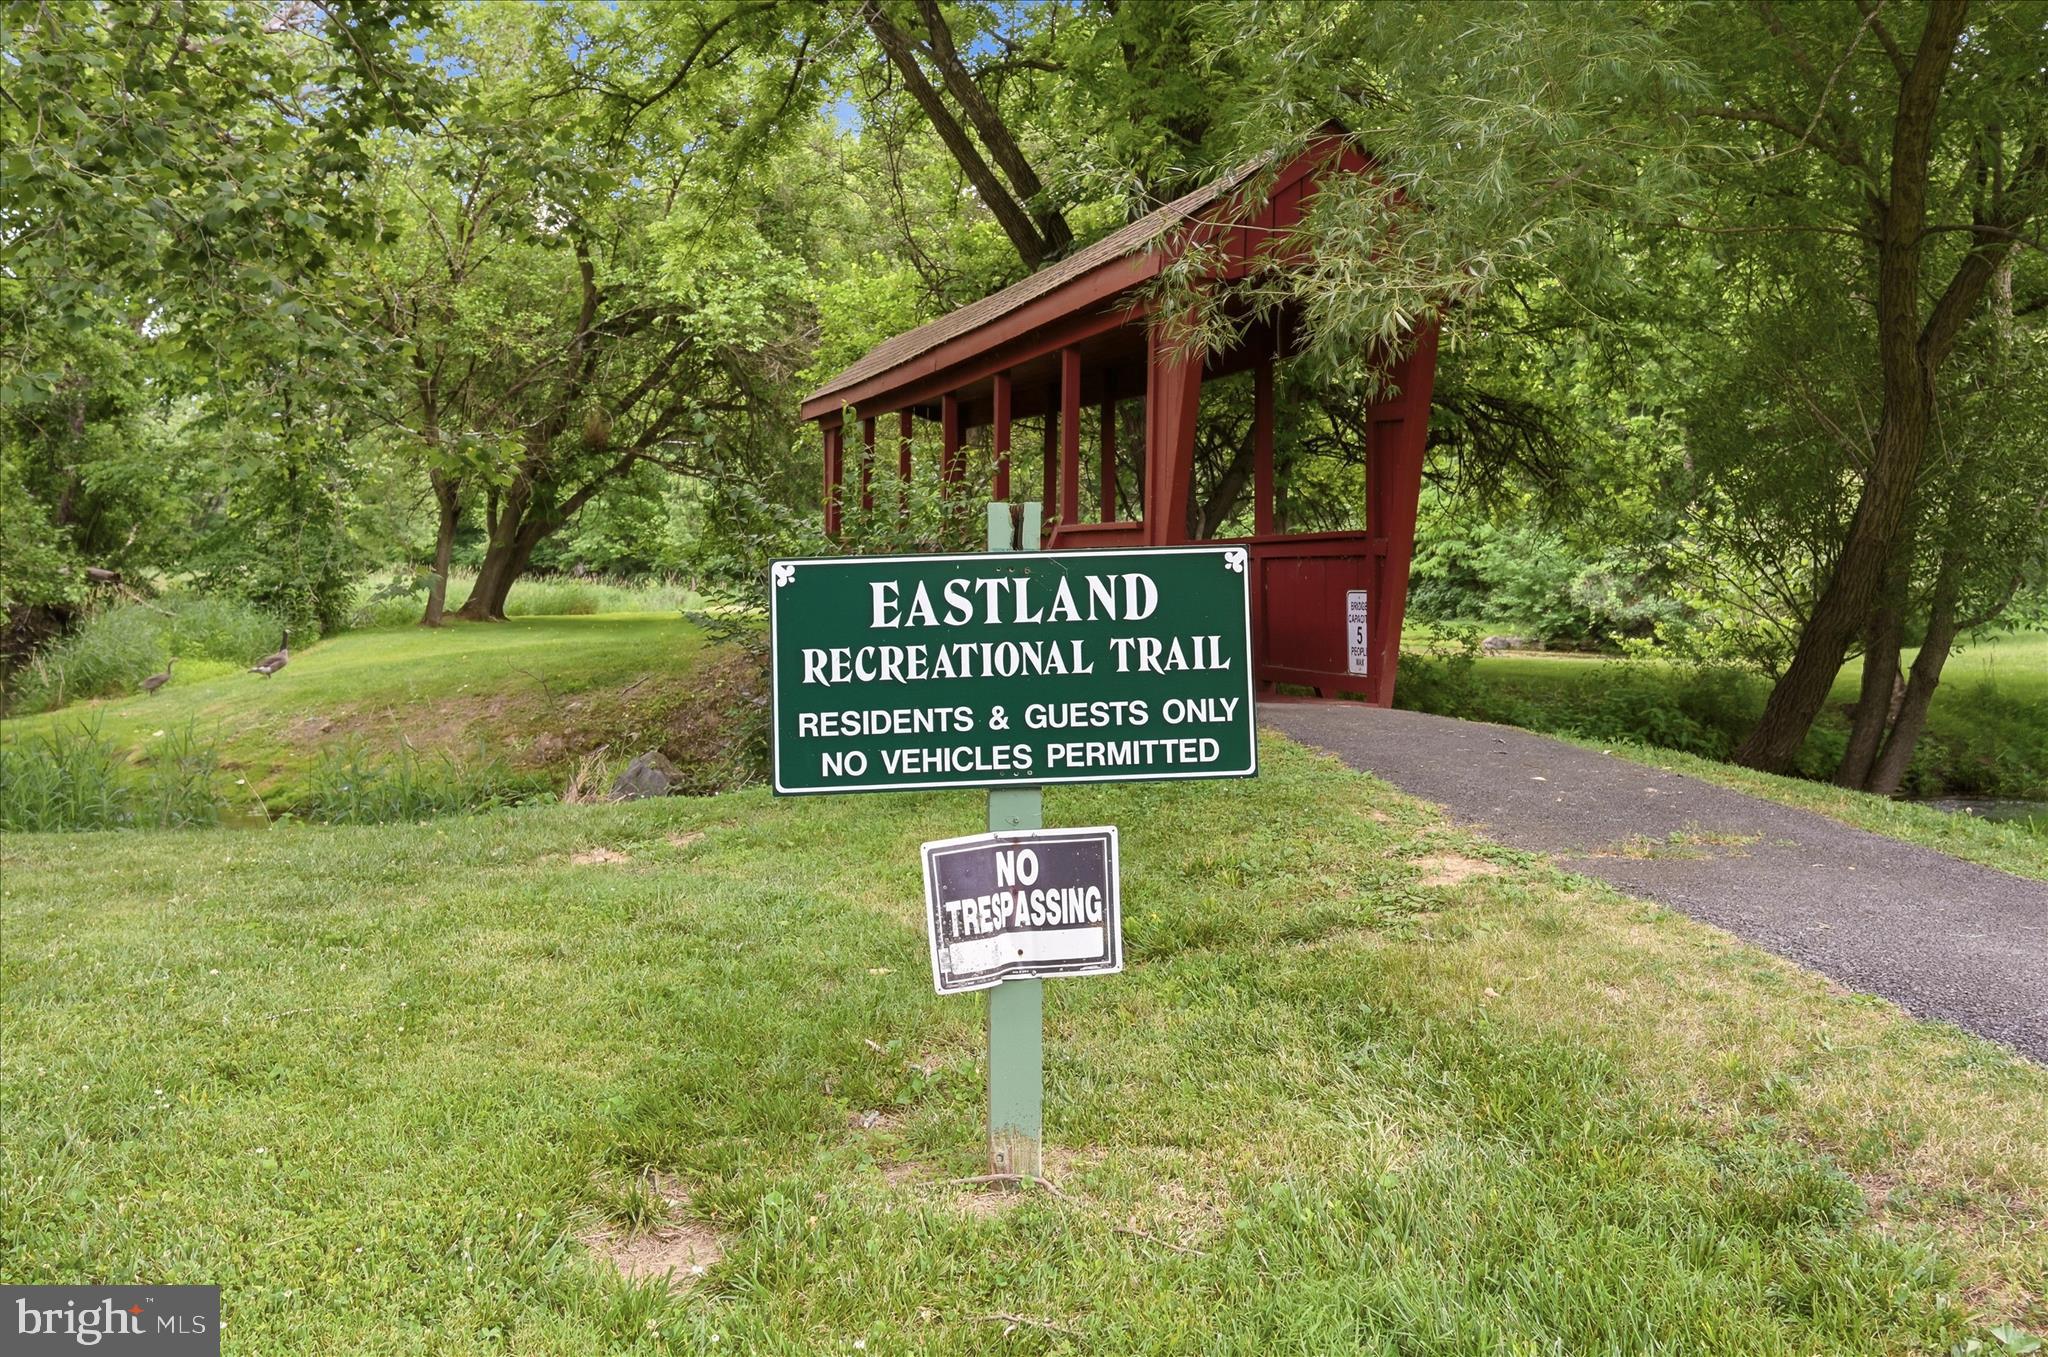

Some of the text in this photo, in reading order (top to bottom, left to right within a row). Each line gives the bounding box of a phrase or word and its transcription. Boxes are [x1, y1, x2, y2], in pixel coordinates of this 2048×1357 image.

[869, 573, 1158, 629] EASTLAND
[1351, 646, 1367, 656] PEOPL
[1356, 626, 1363, 644] 5
[802, 636, 1231, 687] RECREATIONAL TRAIL
[798, 697, 1240, 738] RESIDENTS & GUESTS ONLY
[821, 738, 1220, 777] NO VEHICLES PERMITTED
[995, 849, 1039, 888] NO
[945, 886, 1103, 938] TRESPASSING
